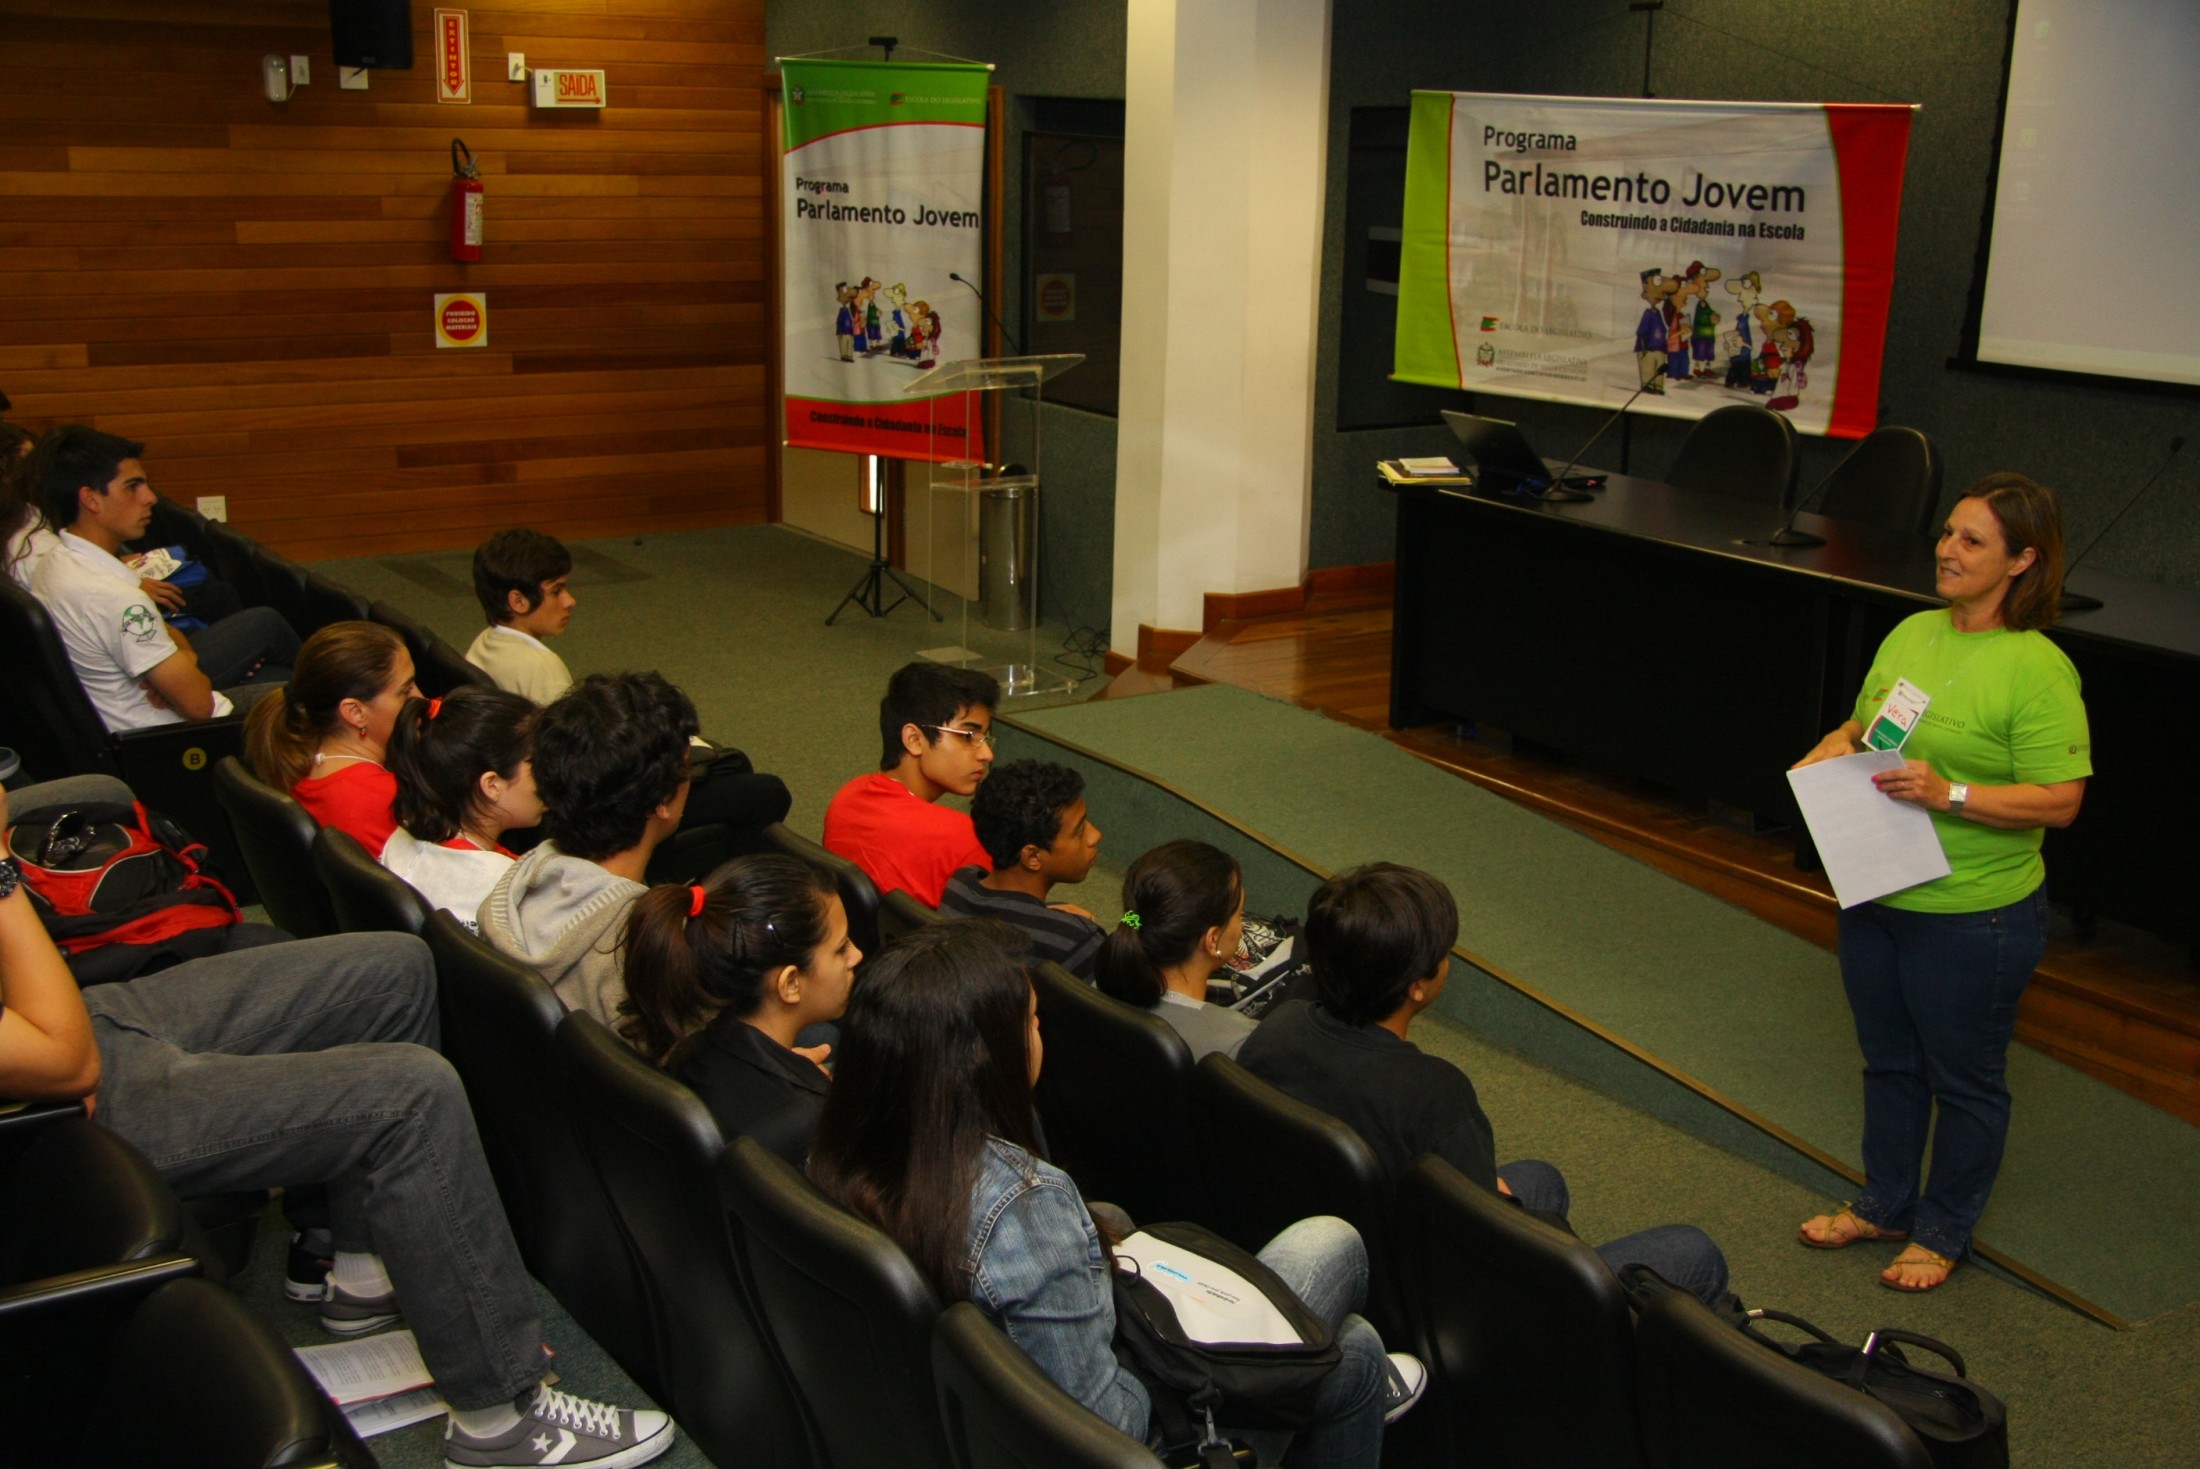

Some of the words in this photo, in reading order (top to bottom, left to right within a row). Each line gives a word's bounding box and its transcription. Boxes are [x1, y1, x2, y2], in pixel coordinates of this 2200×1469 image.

[448, 21, 458, 86] EXTINTOR
[1484, 126, 1577, 152] Programa
[796, 177, 849, 195] Programa
[1484, 160, 1671, 205] Parlamento
[1682, 173, 1806, 213] Jovem
[796, 198, 906, 224] Parlamento
[912, 204, 979, 228] Jovem
[1580, 210, 1657, 231] Construindo
[1659, 218, 1667, 231] a
[1670, 216, 1735, 237] Cidadania
[1738, 223, 1755, 238] na
[1759, 222, 1805, 241] Escola
[810, 410, 865, 428] Construindo
[875, 417, 922, 433] Cidadania
[1887, 703, 1907, 728] Vera
[190, 753, 201, 765] B
